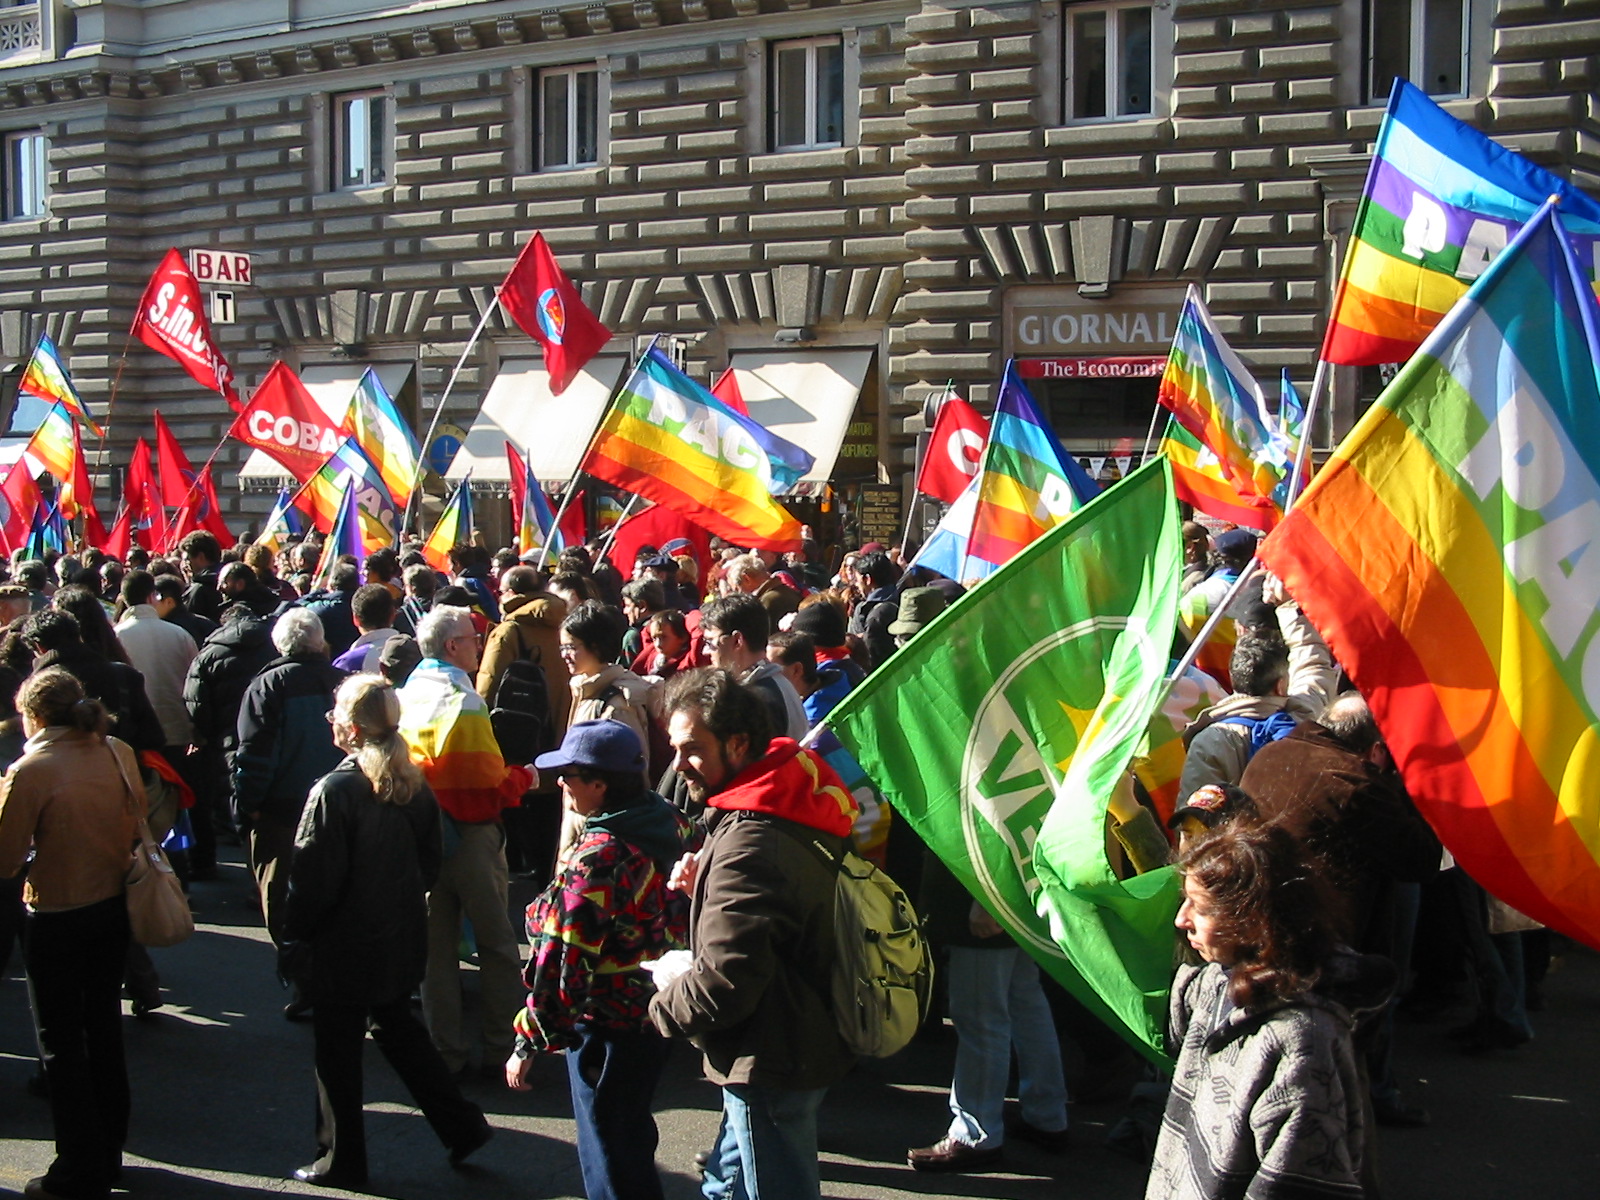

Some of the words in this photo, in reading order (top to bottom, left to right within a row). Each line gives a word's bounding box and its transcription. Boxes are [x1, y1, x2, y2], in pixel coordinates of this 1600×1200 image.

[196, 253, 250, 282] BAR
[217, 293, 231, 321] T
[1018, 312, 1180, 345] GIORNAL
[1041, 361, 1074, 377] The
